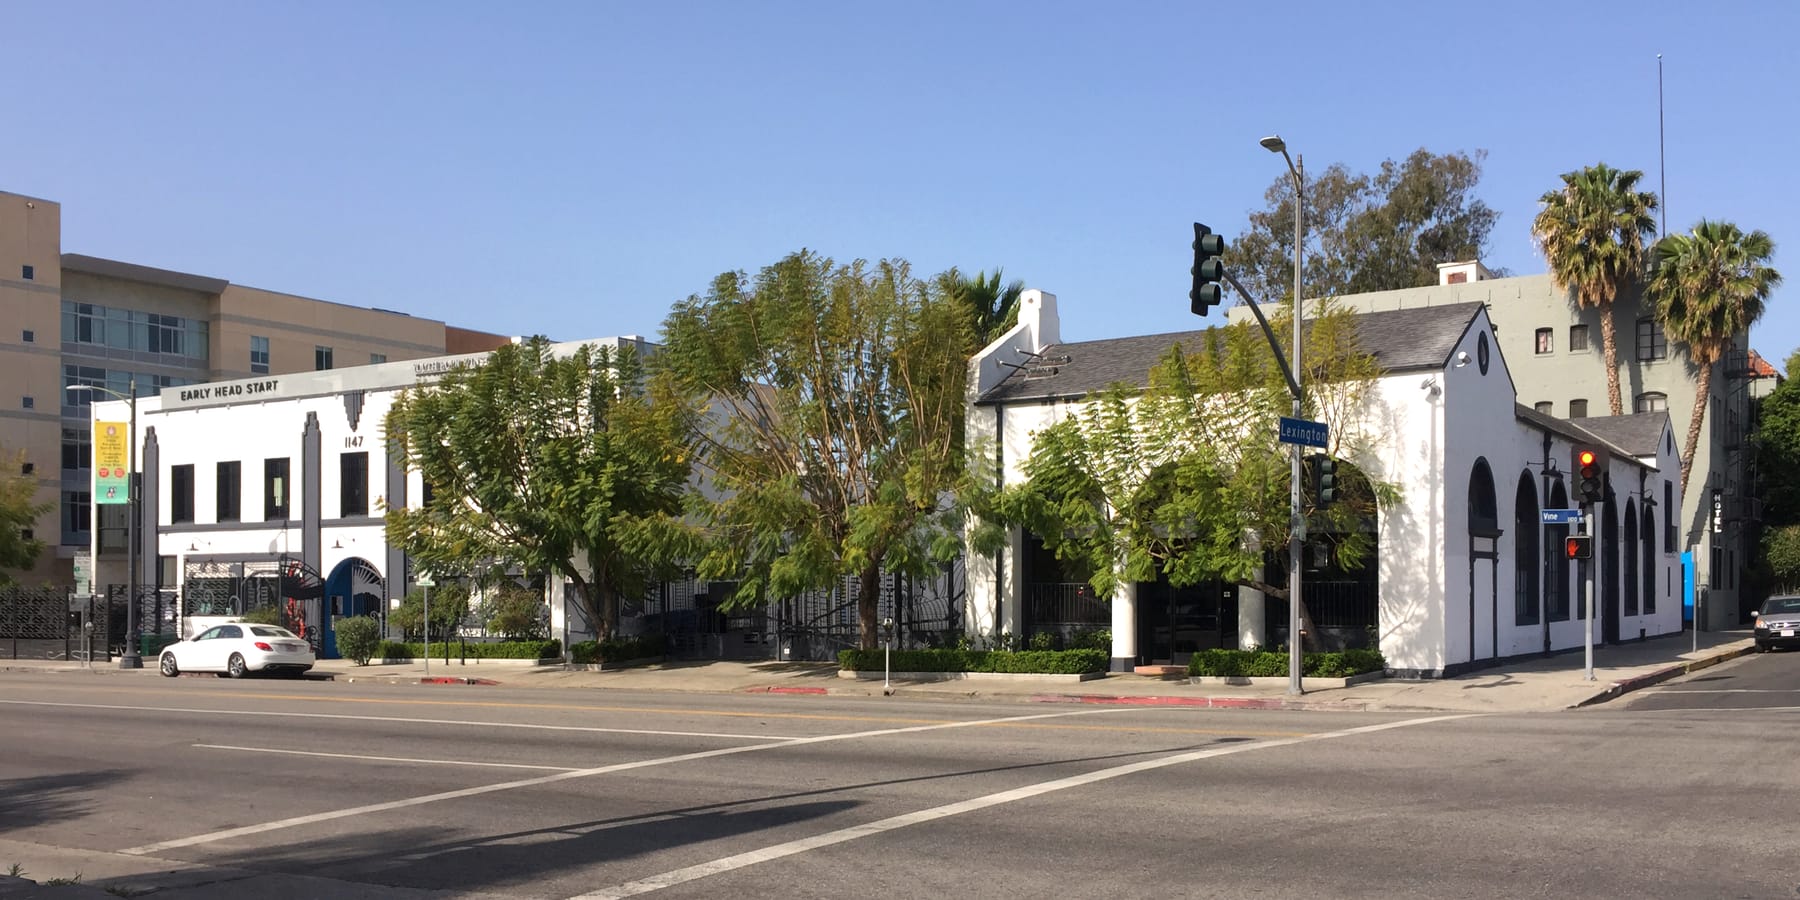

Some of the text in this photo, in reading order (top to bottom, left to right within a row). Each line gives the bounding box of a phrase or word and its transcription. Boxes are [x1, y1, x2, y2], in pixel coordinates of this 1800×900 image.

[180, 380, 279, 401] EARLY HEAD START
[345, 435, 364, 449] 1147
[1281, 423, 1327, 444] Lexington
[1543, 511, 1558, 521] Vine
[1713, 494, 1722, 533] HOTEL
